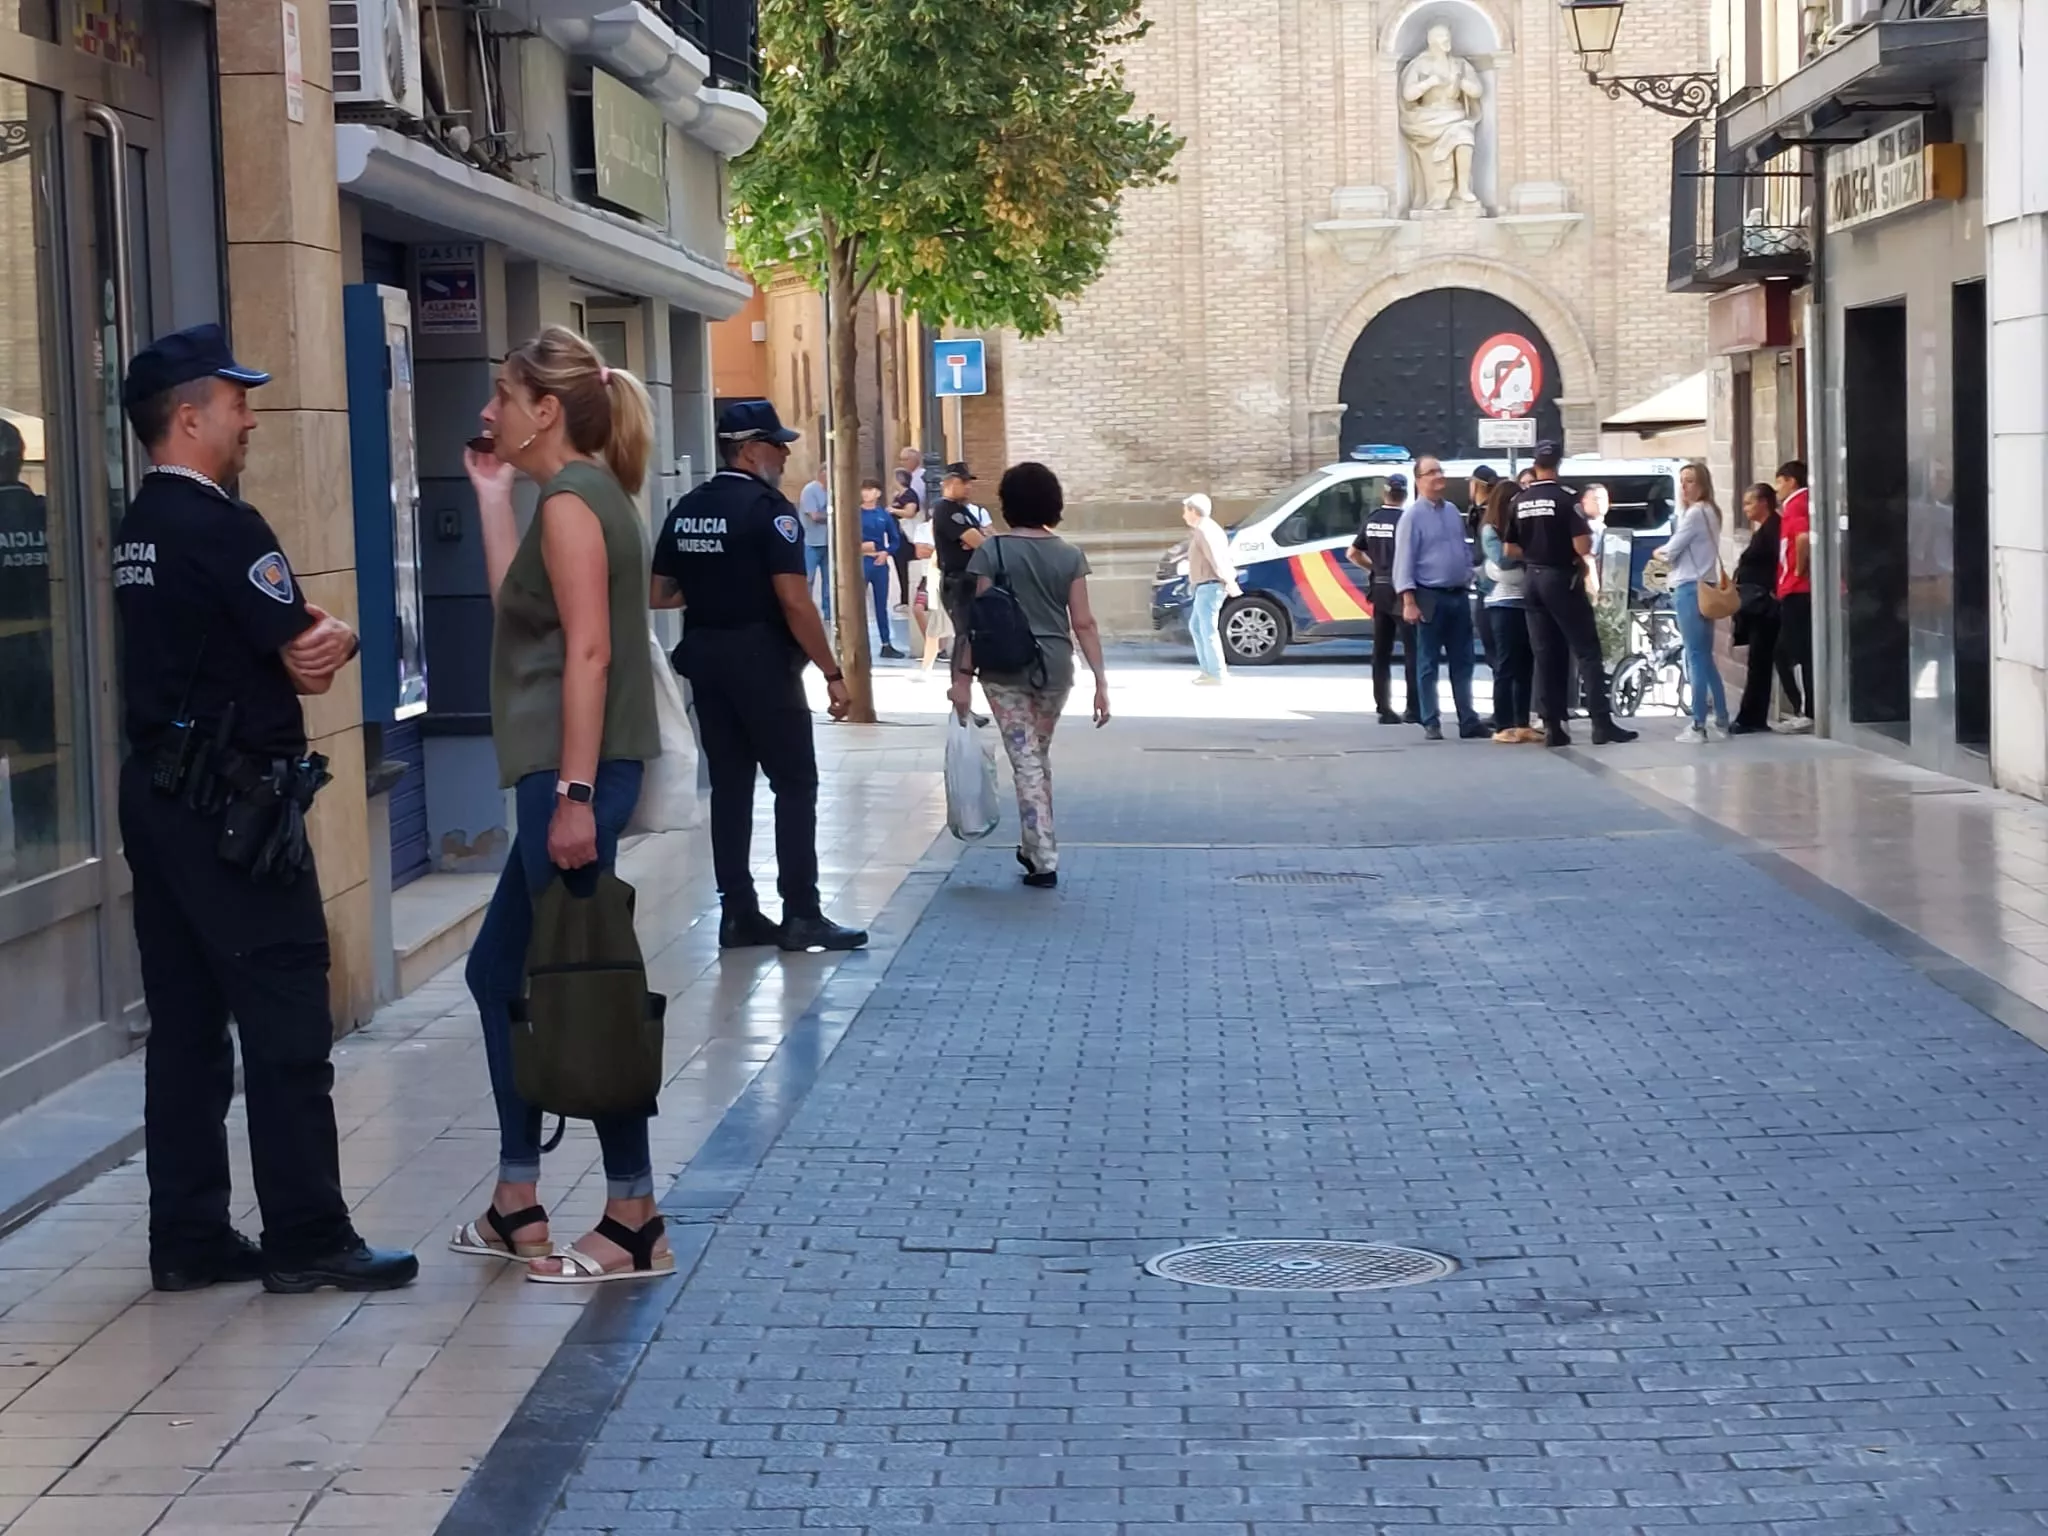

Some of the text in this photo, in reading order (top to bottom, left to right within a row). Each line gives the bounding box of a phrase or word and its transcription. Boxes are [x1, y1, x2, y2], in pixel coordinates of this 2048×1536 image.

[1834, 160, 1919, 221] OMEGA SUIZA
[674, 517, 727, 534] POLICIA
[677, 538, 725, 553] HUESCA
